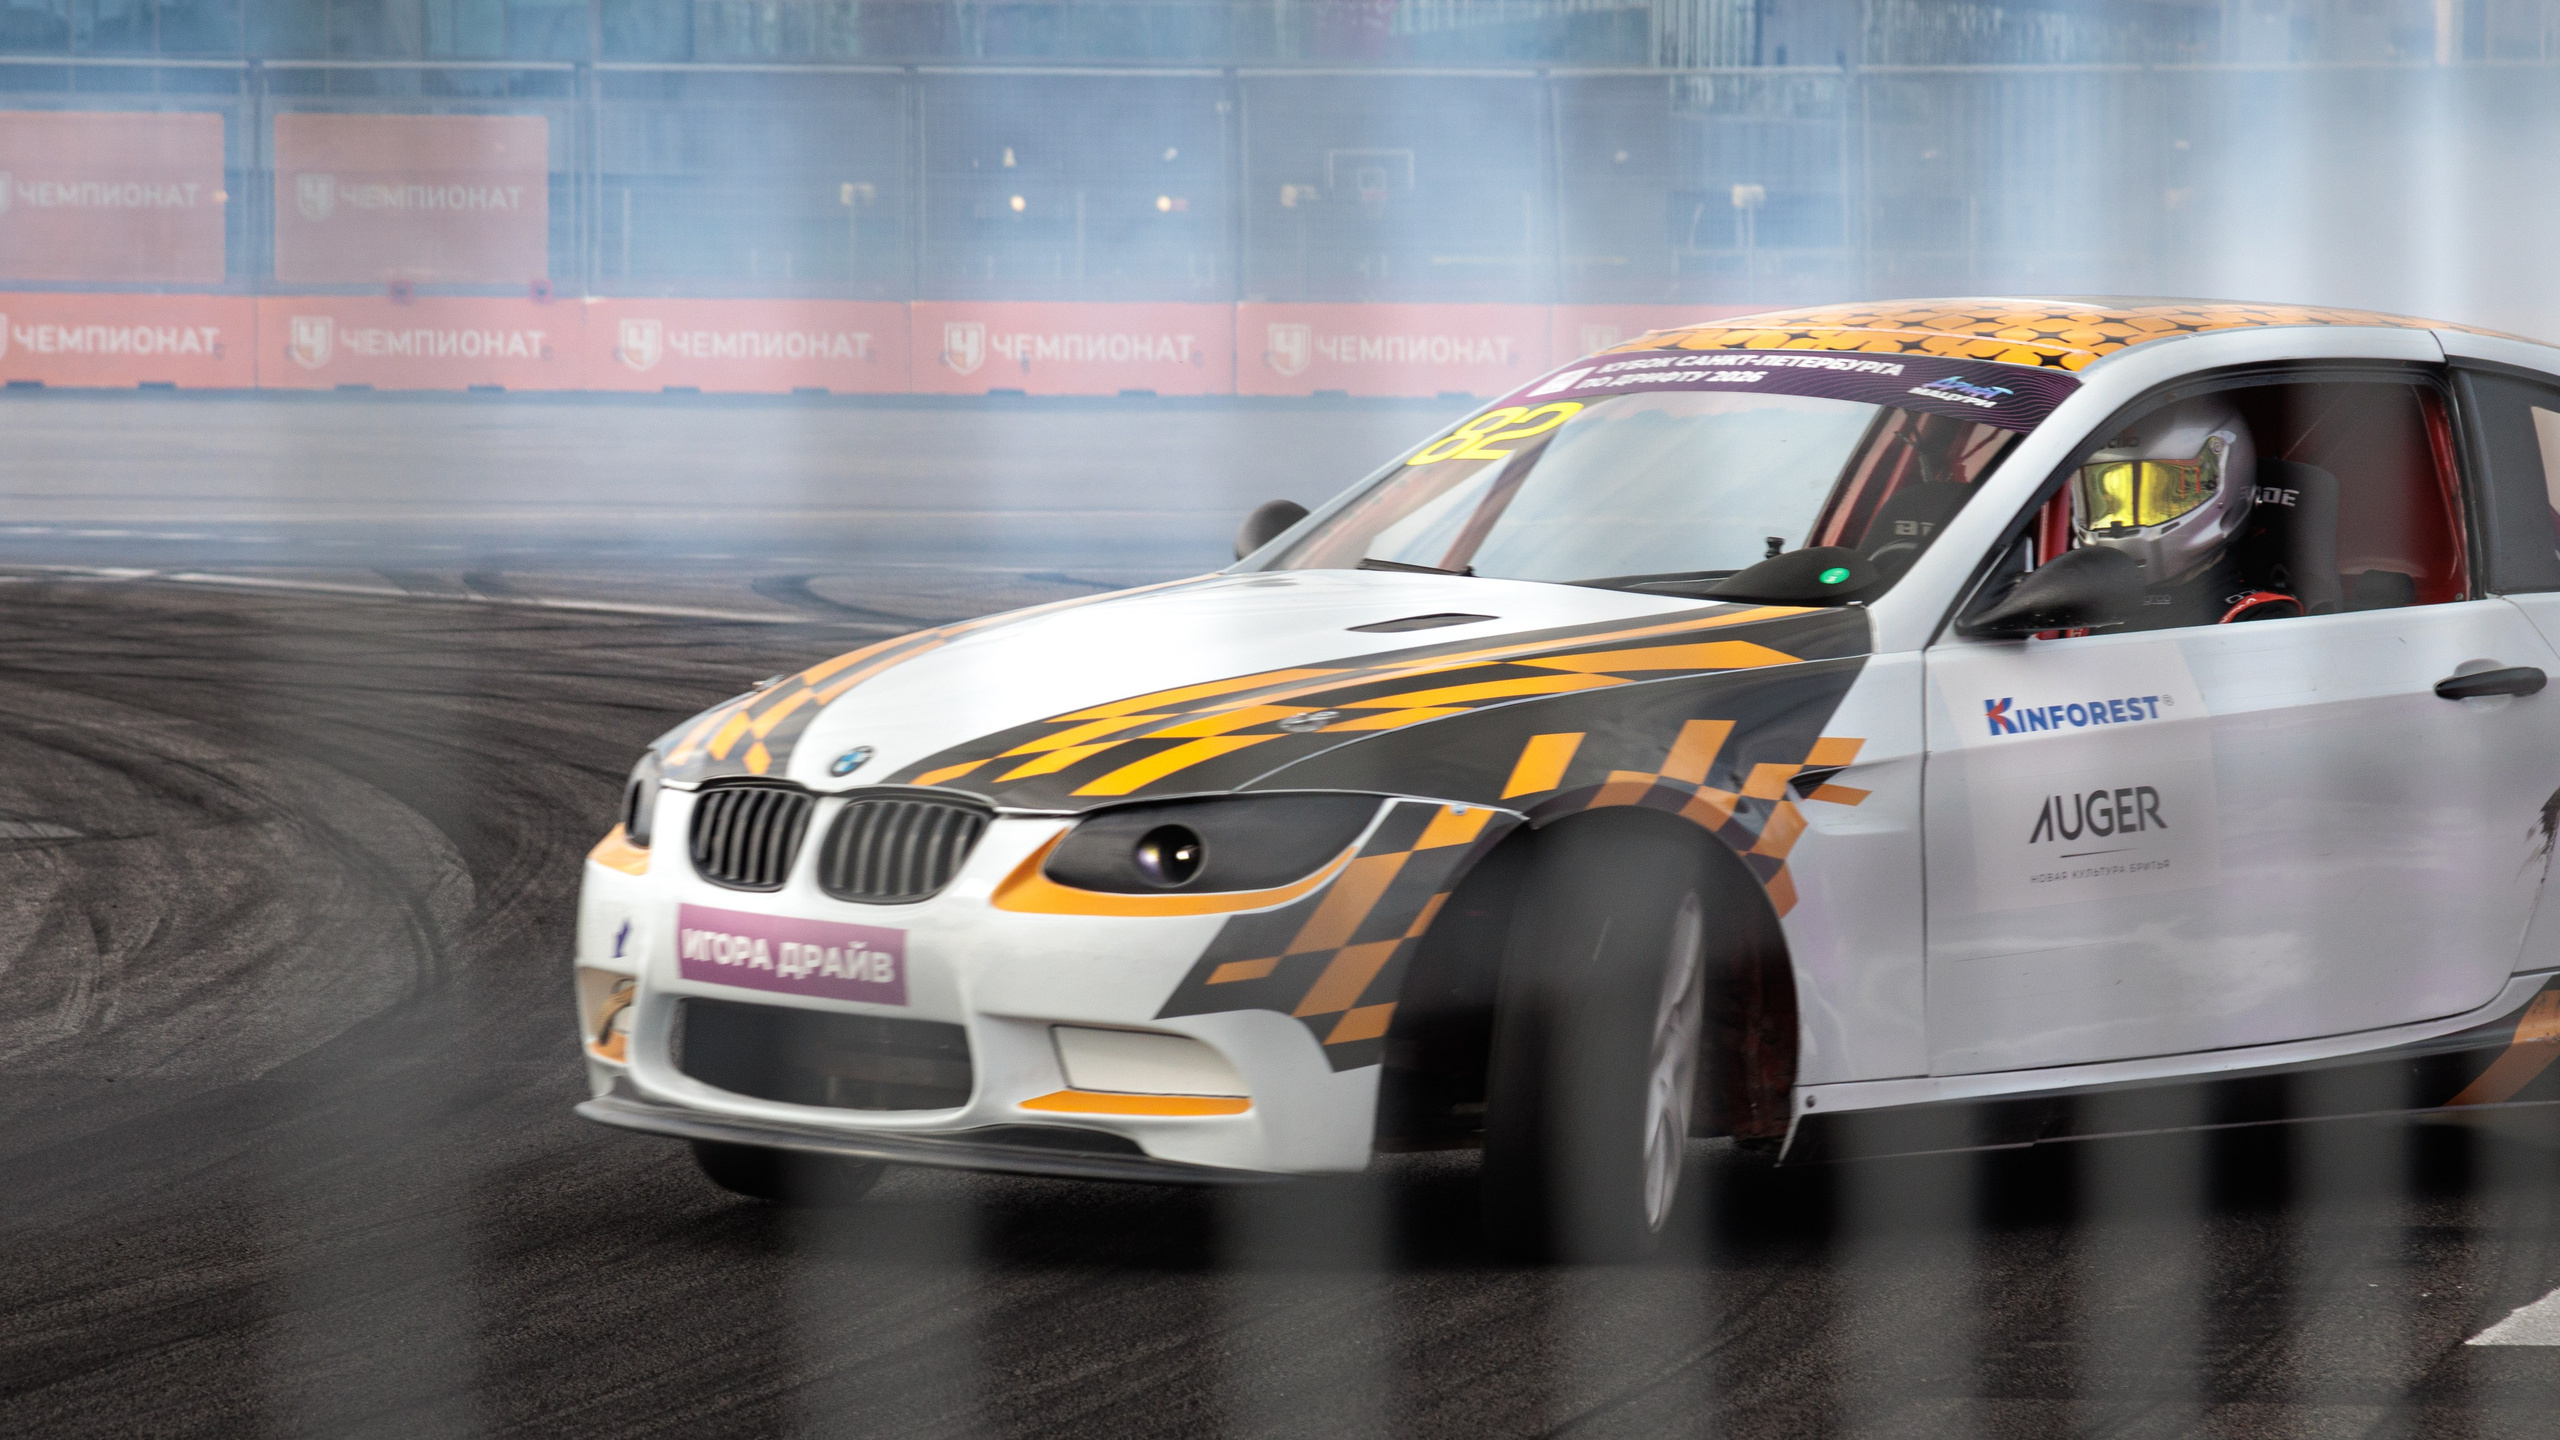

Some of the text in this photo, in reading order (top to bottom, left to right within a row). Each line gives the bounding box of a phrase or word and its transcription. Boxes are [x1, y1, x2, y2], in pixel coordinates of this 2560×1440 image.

[16, 181, 200, 208] ЧЕМПИОНАТ
[340, 184, 523, 211] ЧЕМПИОНАТ
[13, 324, 220, 355] ЧЕМПИОНАТ
[339, 327, 547, 357] ЧЕМПИОНАТ
[668, 330, 873, 359] ЧЕМПИОНАТ
[991, 333, 1195, 362] ЧЕМПИОНАТ
[1316, 334, 1514, 364] ЧЕМПИОНАТ
[1573, 375, 1614, 389] ПО
[1606, 371, 1707, 387] ДРИФТУ
[1704, 370, 1769, 383] 2026
[1596, 354, 1905, 377] КУБОК САНКТ-ПЕТЕРБУРГА
[1405, 401, 1585, 466] 82
[2030, 858, 2171, 884] НОВАЯ КУЛЬТУРА БРИТЬЯ
[681, 927, 897, 984] ИГОРА ДРАЙВ
